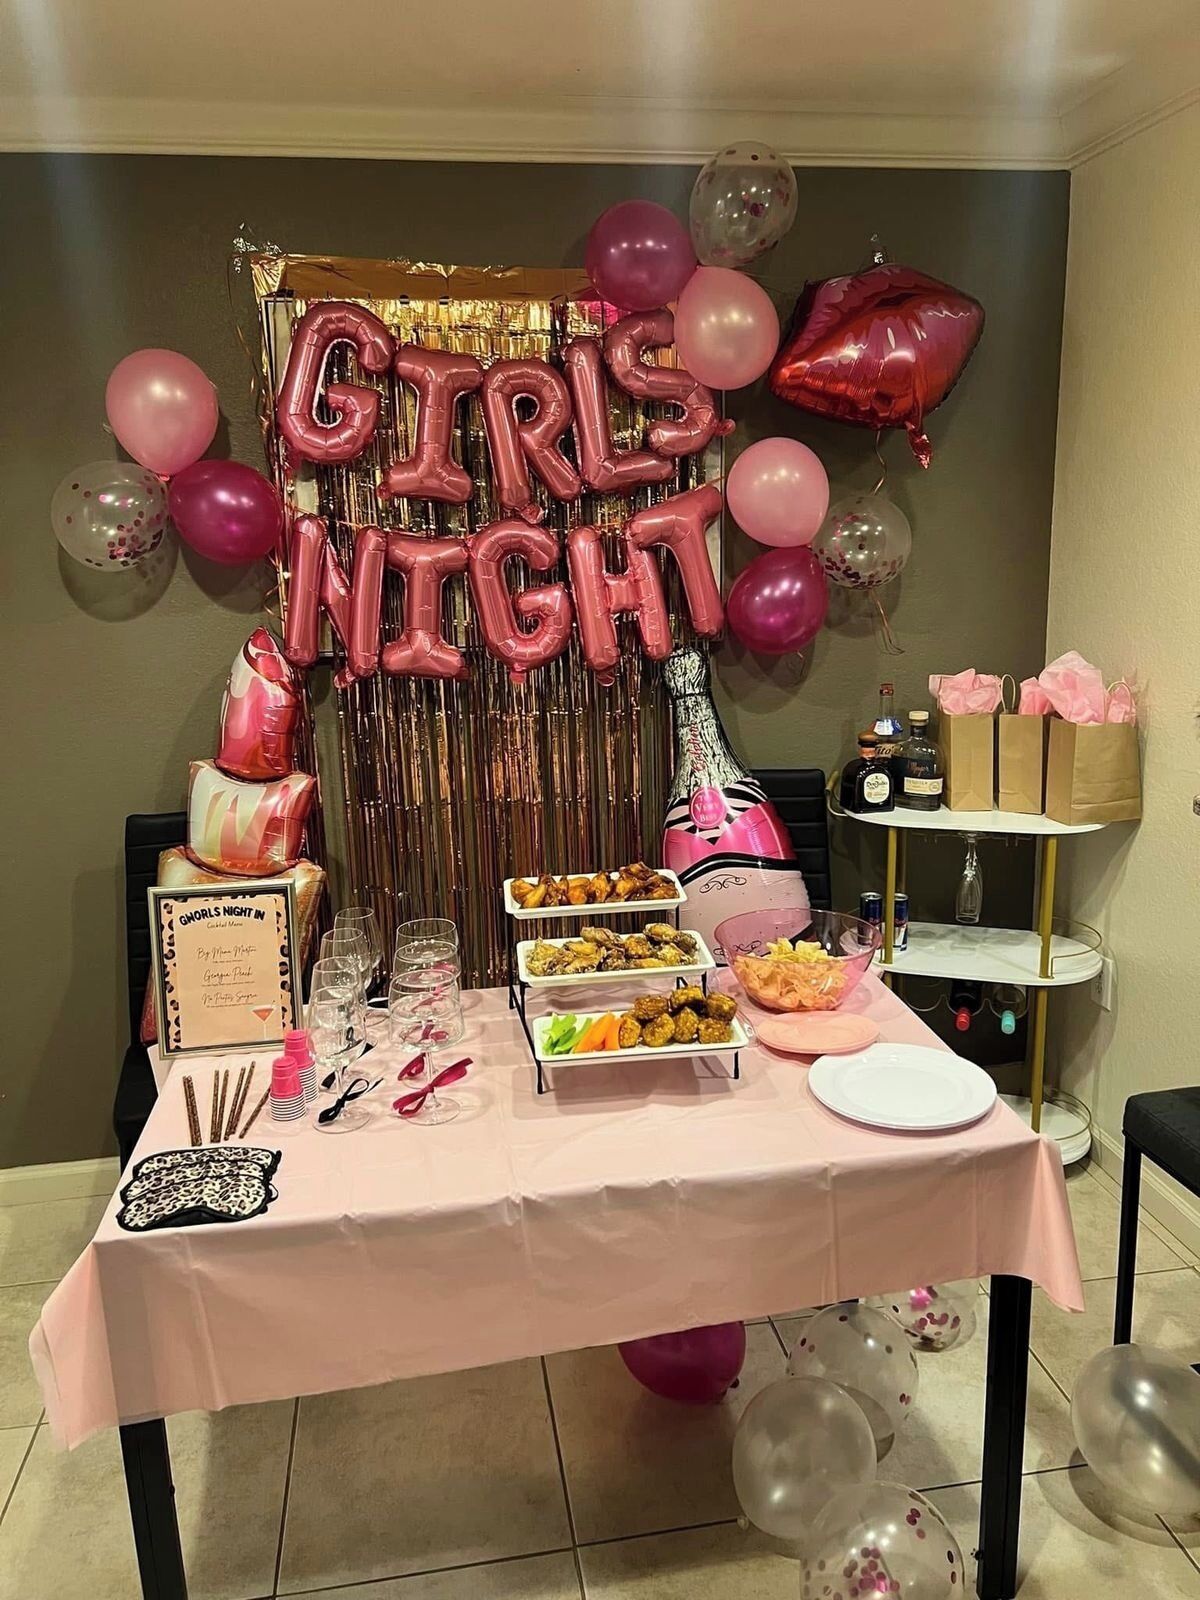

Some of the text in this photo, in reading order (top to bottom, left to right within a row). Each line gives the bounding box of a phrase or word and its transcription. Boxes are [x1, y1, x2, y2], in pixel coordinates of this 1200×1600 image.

[278, 302, 720, 510] GIRLS
[284, 486, 724, 678] NIGHT
[223, 906, 253, 918] NIGHT
[254, 908, 266, 921] IN
[231, 966, 252, 981] Peach
